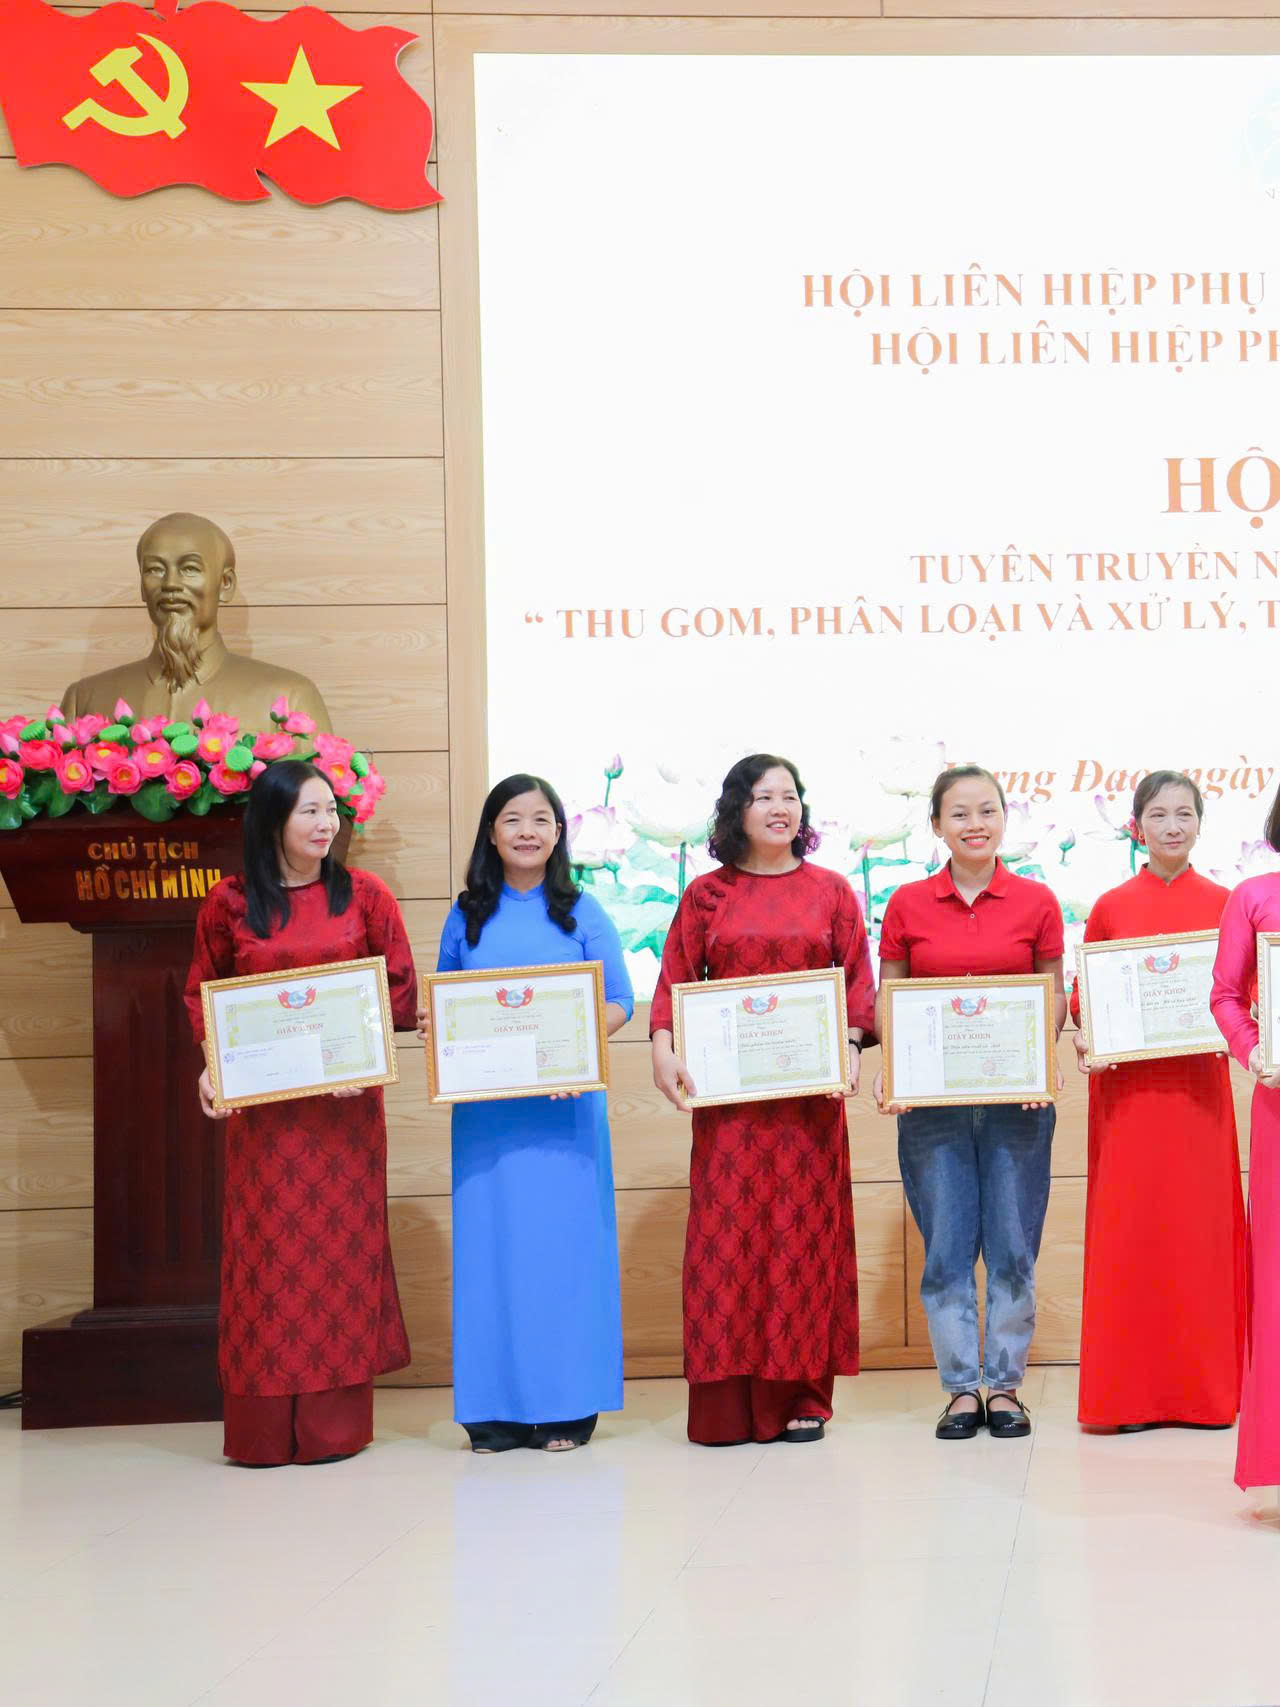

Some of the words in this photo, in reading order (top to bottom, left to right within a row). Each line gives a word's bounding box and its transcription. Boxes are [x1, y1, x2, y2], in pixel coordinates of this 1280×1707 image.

[803, 269, 890, 318] HỘI
[911, 262, 1023, 307] LIÊN
[1043, 268, 1157, 315] HIỆP
[1171, 272, 1264, 314] PHỤ
[872, 327, 957, 375] HỘI
[978, 320, 1089, 364] LIÊN
[1111, 325, 1224, 373] HIỆP
[910, 544, 1053, 584] TUYÊN
[1067, 543, 1238, 581] TRUYỀN
[556, 608, 644, 638] THU
[660, 607, 775, 640] GOM,
[791, 596, 903, 635] PHÂN
[920, 603, 1021, 641] LOẠI
[1037, 594, 1094, 631] VÀ
[1108, 593, 1170, 631] XỬ
[1183, 592, 1246, 634] LÝ,
[88, 836, 136, 860] CHỦ
[144, 838, 199, 863] TỊCH
[75, 864, 111, 900] HỒ
[115, 861, 157, 899] CHÍ
